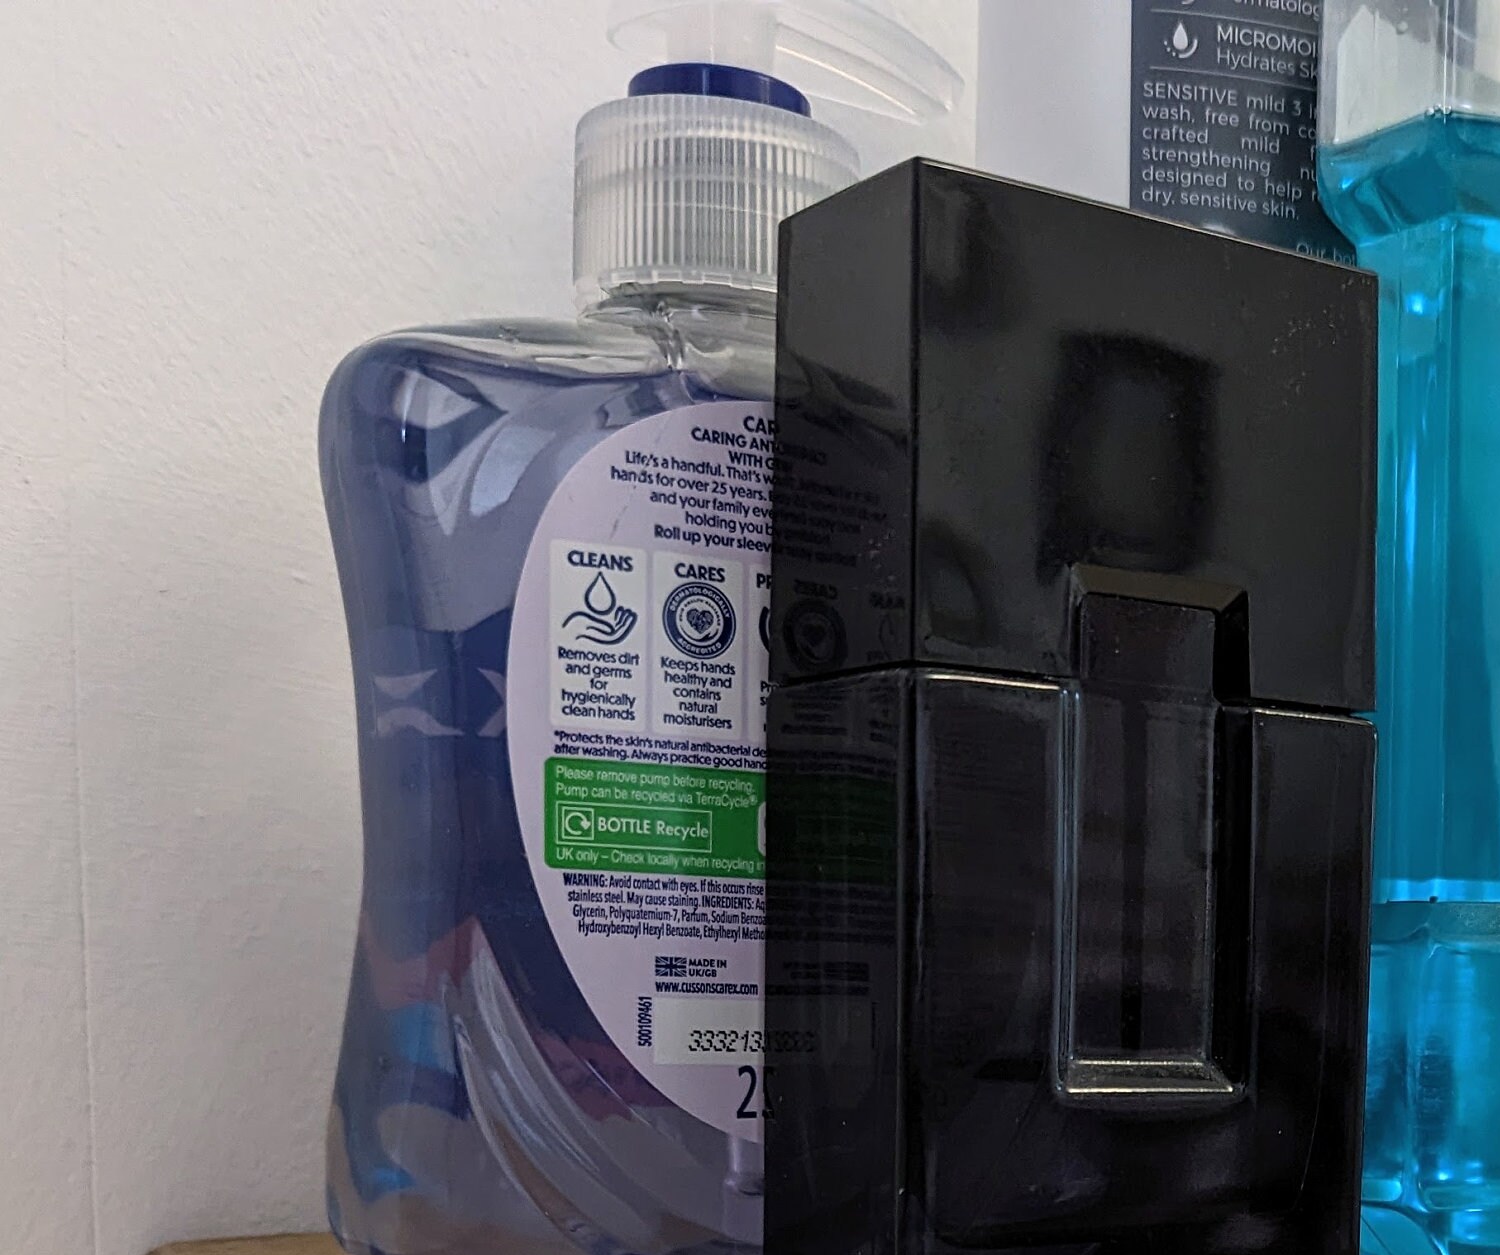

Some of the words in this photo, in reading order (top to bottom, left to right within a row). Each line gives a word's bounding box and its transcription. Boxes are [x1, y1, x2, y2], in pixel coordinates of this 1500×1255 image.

[1216, 24, 1317, 57] MICROMOI
[1217, 49, 1295, 73] Hydrates
[1144, 83, 1237, 105] SENSITIVE
[1247, 94, 1284, 113] mild
[1292, 101, 1300, 116] 3
[1143, 105, 1195, 124] wash,
[1205, 109, 1239, 127] free
[1250, 115, 1289, 135] from
[1143, 125, 1208, 144] crafted
[1242, 135, 1280, 154] mild
[1143, 148, 1270, 177] strengthening
[1143, 167, 1227, 188] designed
[1238, 175, 1254, 191] to
[1266, 182, 1302, 202] help
[1142, 187, 1175, 206] dry,
[1181, 192, 1257, 214] sensitive
[1263, 202, 1299, 220] skin.
[691, 427, 747, 449] CARING
[625, 450, 659, 468] Life's
[671, 456, 724, 477] handful.
[727, 467, 760, 484] That's
[729, 450, 762, 469] WITH
[611, 466, 653, 485] hands
[656, 470, 674, 487] for
[677, 478, 709, 493] over
[711, 481, 726, 495] 25
[730, 484, 767, 501] years.
[650, 491, 677, 504] and
[679, 495, 710, 512] your
[712, 497, 749, 517] family
[685, 512, 736, 535] holding
[739, 521, 764, 537] you
[654, 524, 680, 540] Roll
[683, 530, 701, 546] up
[704, 532, 735, 549] your
[567, 550, 633, 573] CLEANS
[674, 563, 725, 583] CARES
[558, 646, 616, 663] Removes
[619, 652, 639, 665] dirt
[661, 657, 698, 673] Keeps
[700, 662, 735, 675] hands
[566, 663, 590, 675] and
[593, 666, 631, 680] germs
[664, 671, 707, 688] healthy
[710, 676, 732, 688] and
[590, 678, 607, 690] for
[673, 687, 721, 702] contains
[562, 689, 635, 709] hygienically
[680, 701, 717, 714] natural
[562, 703, 597, 718] clean
[599, 707, 635, 720] hands
[664, 713, 732, 729] moisturisers
[554, 743, 579, 754] after
[582, 745, 629, 761] washing.
[631, 749, 668, 763] Always
[670, 752, 712, 765] practice
[713, 757, 742, 768] good
[605, 734, 622, 746] the
[625, 736, 652, 749] skin's
[654, 739, 689, 751] natural
[690, 742, 751, 757] antibacterial
[556, 766, 594, 780] Please
[597, 770, 636, 782] remove
[640, 773, 670, 786] pump
[674, 773, 707, 788] before
[709, 778, 756, 793] recycling.
[556, 783, 589, 798] Pump
[592, 787, 611, 798] can
[615, 787, 627, 800] be
[632, 789, 675, 803] recycled
[597, 817, 650, 835] BOTTLE
[657, 821, 709, 840] Recycle
[556, 848, 572, 860] UK
[576, 849, 599, 864] only
[611, 850, 643, 864] Check
[649, 852, 678, 867] locally
[682, 855, 709, 868] when
[712, 857, 754, 873] recycling
[563, 872, 608, 887] WARNING:
[609, 875, 632, 889] Avoid
[633, 878, 660, 890] contact
[662, 878, 678, 890] with
[680, 882, 699, 893] eyes.
[701, 879, 706, 890] If
[708, 881, 721, 892] this
[723, 883, 745, 894] occurs
[747, 883, 764, 895] rinse
[568, 890, 603, 903] stainless
[605, 892, 625, 904] steel.
[627, 892, 643, 907] May
[645, 896, 666, 906] cause
[668, 895, 701, 911] staining.
[702, 895, 754, 910] INGREDIENTS:
[573, 904, 608, 920] Glycerin,
[609, 907, 680, 923] Polyquaternium-7,
[682, 911, 710, 924] Parfum,
[712, 912, 739, 924] Sodium
[578, 921, 641, 937] Hydroxybenzoyl
[643, 923, 664, 938] Hexyl
[666, 926, 702, 940] Benzoate,
[704, 926, 740, 943] Ethylhexyl
[689, 959, 715, 968] MADE
[717, 960, 727, 968] IN
[689, 969, 717, 977] UK/GB
[655, 981, 758, 995] www.cussonscarex.com
[689, 1030, 764, 1052] 333213
